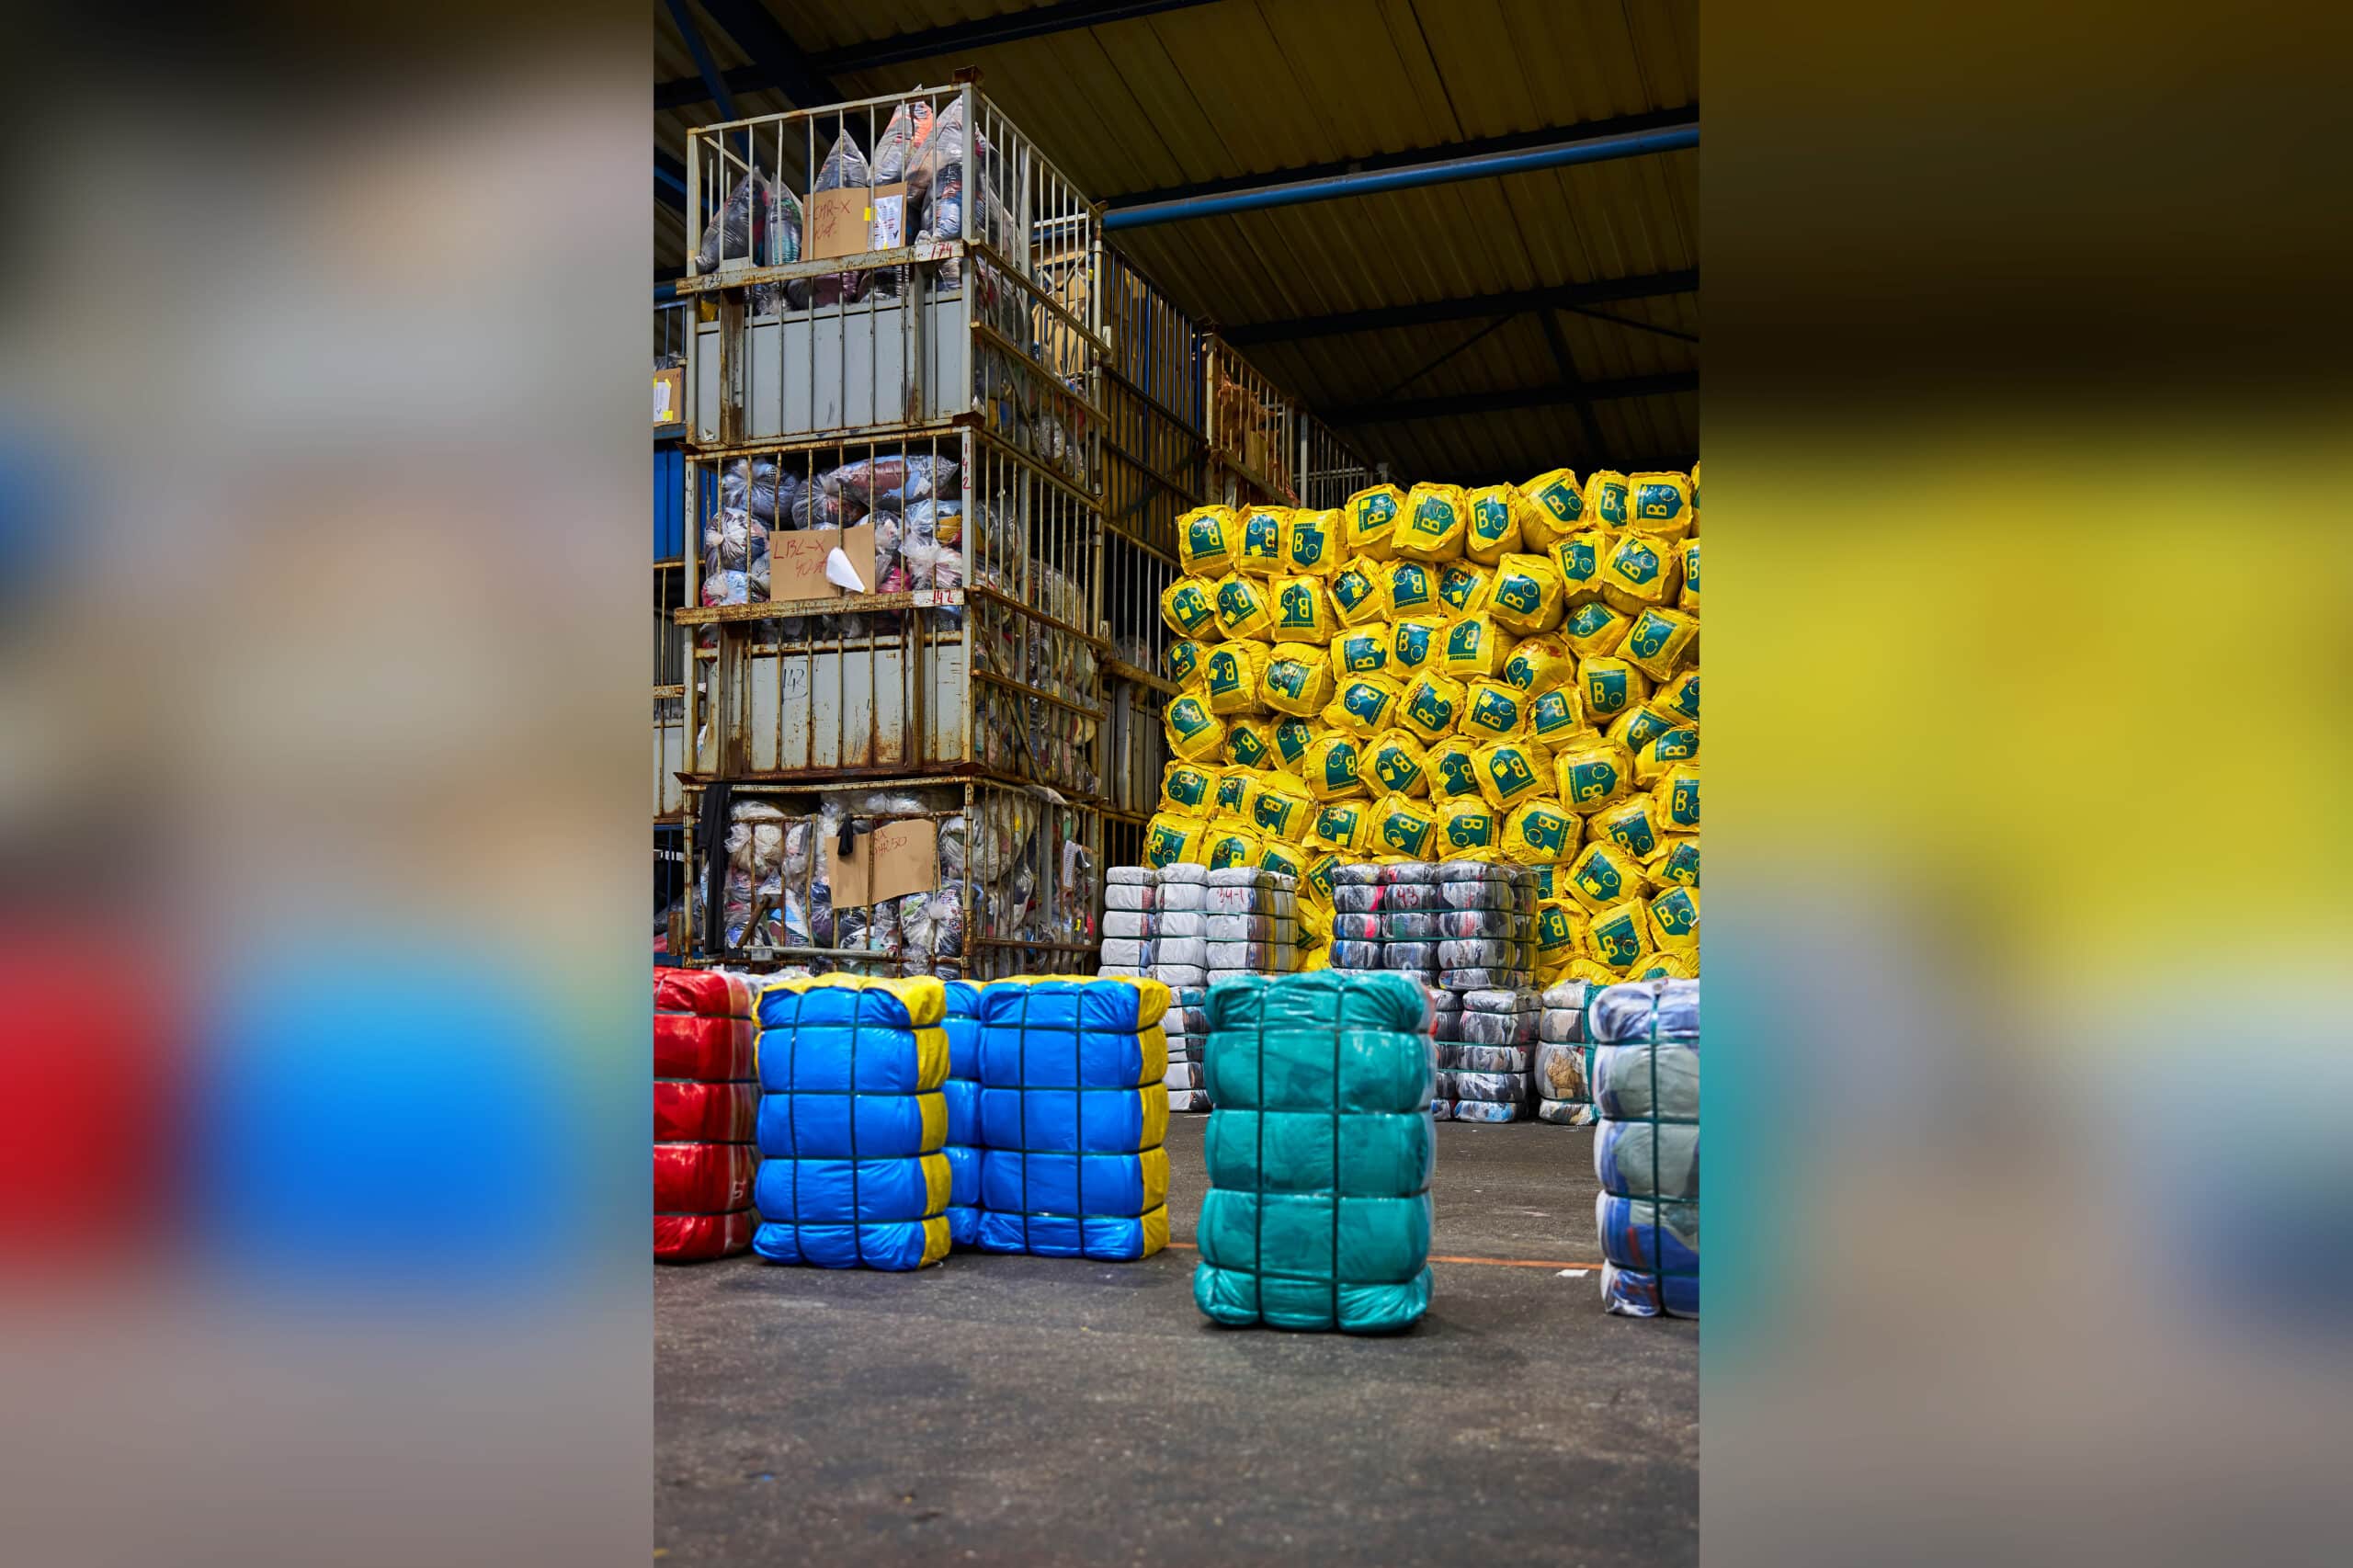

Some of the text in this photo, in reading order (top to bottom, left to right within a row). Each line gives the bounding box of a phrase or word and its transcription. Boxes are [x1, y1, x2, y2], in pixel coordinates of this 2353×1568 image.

[930, 242, 952, 261] 174
[932, 587, 954, 604] 142
[1397, 885, 1419, 908] 43
